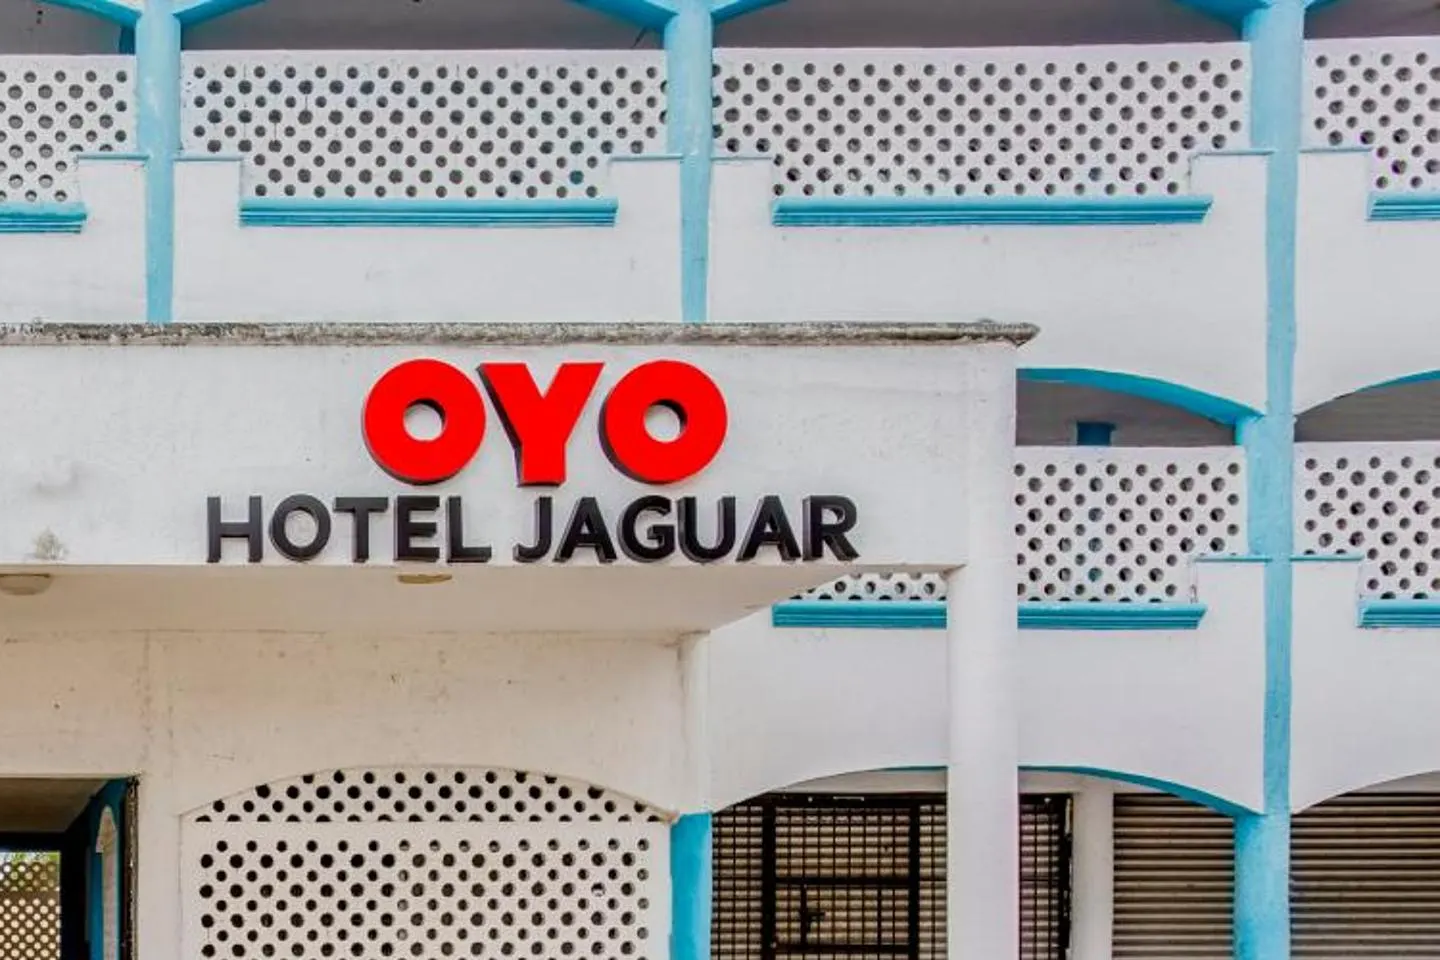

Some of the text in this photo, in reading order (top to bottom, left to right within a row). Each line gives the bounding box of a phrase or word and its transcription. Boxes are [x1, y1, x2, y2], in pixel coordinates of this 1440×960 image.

[363, 358, 728, 486] OYO
[206, 494, 861, 565] HOTEL JAGUAR
